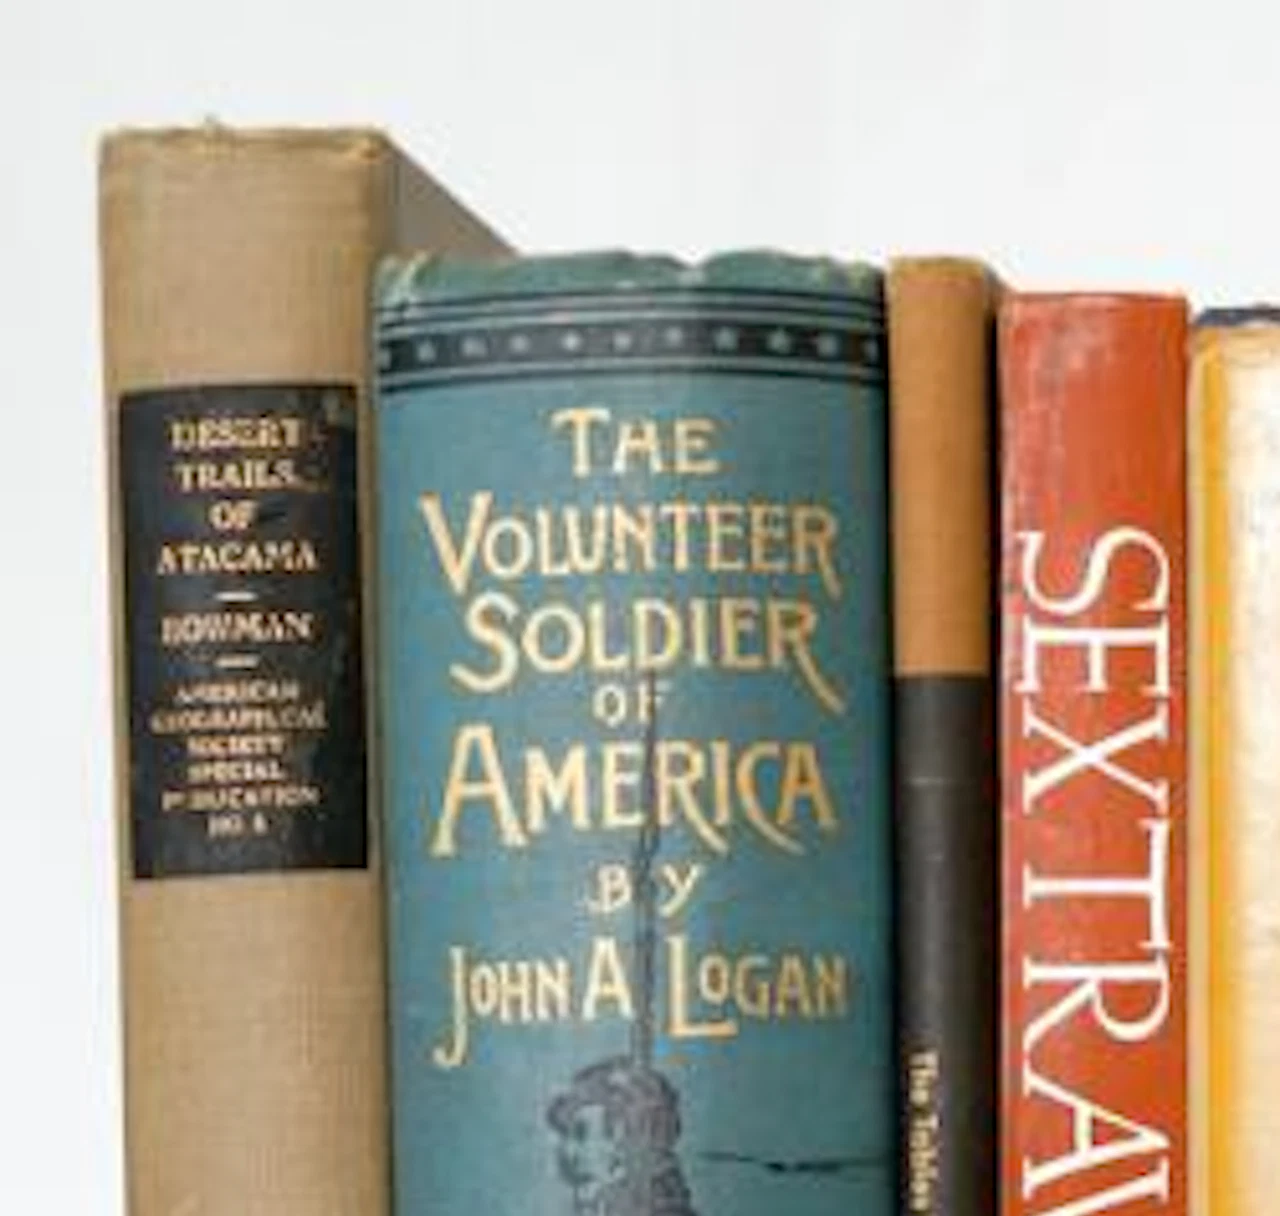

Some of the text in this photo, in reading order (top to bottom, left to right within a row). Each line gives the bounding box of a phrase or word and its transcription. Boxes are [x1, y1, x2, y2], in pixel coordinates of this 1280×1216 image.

[170, 416, 301, 450] DESERT
[551, 408, 726, 479] THE
[174, 459, 298, 493] TRAILS
[209, 500, 257, 533] OF
[157, 541, 318, 576] ATACAMA
[420, 490, 843, 596] VOLUNTEER
[161, 611, 312, 644] BOWMAN
[450, 592, 848, 715] SOLDIER
[592, 684, 668, 728] OF
[430, 723, 842, 859] AMERICA
[588, 864, 705, 916] BY
[433, 938, 852, 1070] JOHN A LOGAN
[907, 1052, 940, 1104] The
[907, 1112, 940, 1212] Tables
